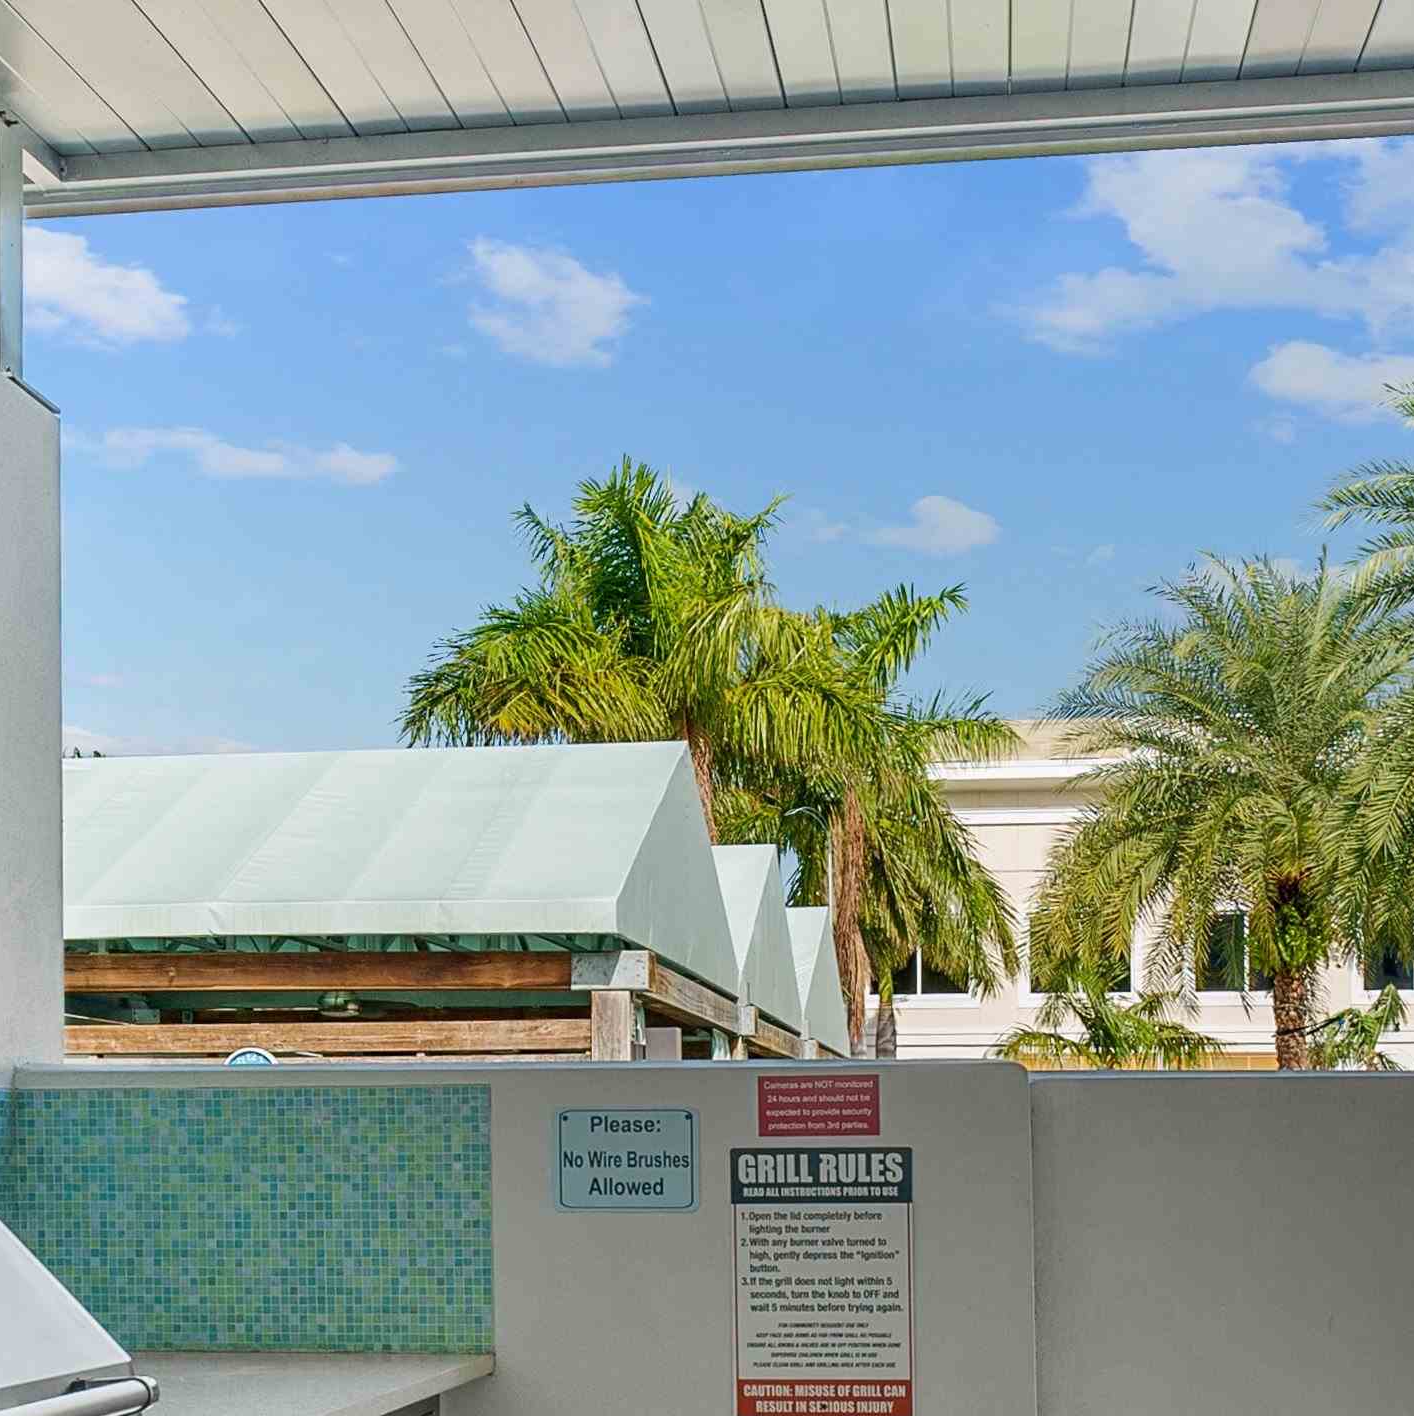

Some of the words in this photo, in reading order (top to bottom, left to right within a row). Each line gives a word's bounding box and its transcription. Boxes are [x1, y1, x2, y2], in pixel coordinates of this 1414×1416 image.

[763, 1081, 798, 1089] Cameras
[800, 1081, 814, 1089] are
[815, 1081, 834, 1089] NOT
[835, 1080, 873, 1088] monitored
[766, 1109, 801, 1117] expected
[812, 1109, 840, 1117] provide
[842, 1109, 871, 1117] security
[590, 1116, 661, 1133] Please:
[563, 1151, 584, 1168] No
[588, 1151, 622, 1168] Wire
[627, 1151, 690, 1168] Brushes
[738, 1153, 814, 1184] GRILL
[819, 1152, 904, 1184] RULES
[588, 1177, 664, 1195] Allowed
[743, 1187, 765, 1197] READ
[766, 1187, 780, 1197] ALL
[781, 1187, 841, 1197] INSTRUCTIONS
[843, 1187, 869, 1197] PRIOR
[870, 1187, 881, 1197] TO
[882, 1187, 899, 1197] USE
[774, 1211, 787, 1220] the
[790, 1211, 801, 1220] lid
[803, 1211, 850, 1222] completely
[854, 1211, 882, 1220] before
[749, 1225, 783, 1235] lighting
[785, 1225, 799, 1233] the
[801, 1225, 830, 1233] burner
[771, 1239, 787, 1248] any
[790, 1238, 819, 1246] burner
[821, 1238, 844, 1246] valve
[847, 1238, 875, 1246] turned
[878, 1238, 887, 1246] to
[773, 1251, 801, 1261] gently
[803, 1251, 837, 1261] depress
[840, 1251, 854, 1259] the
[758, 1277, 773, 1285] the
[775, 1277, 792, 1287] grill
[795, 1277, 816, 1285] does
[818, 1277, 832, 1285] not
[835, 1277, 854, 1287] light
[857, 1277, 884, 1285] within
[886, 1277, 892, 1285] 5
[791, 1290, 809, 1298] turn
[812, 1290, 825, 1298] the
[828, 1290, 850, 1298] knob
[853, 1290, 861, 1298] to
[863, 1290, 881, 1298] OFF
[883, 1290, 899, 1298] and
[751, 1303, 769, 1312] wait
[771, 1303, 778, 1312] 5
[779, 1303, 815, 1312] minutes
[817, 1303, 846, 1312] before
[848, 1303, 874, 1313] trying
[743, 1385, 793, 1397] CAUTION:
[795, 1385, 836, 1397] MISUSE
[838, 1385, 851, 1397] OF
[853, 1385, 882, 1397] GRILL
[884, 1385, 906, 1397] CAN
[756, 1401, 793, 1413] RESULT
[796, 1401, 807, 1413] IN
[857, 1401, 894, 1413] INJURY
